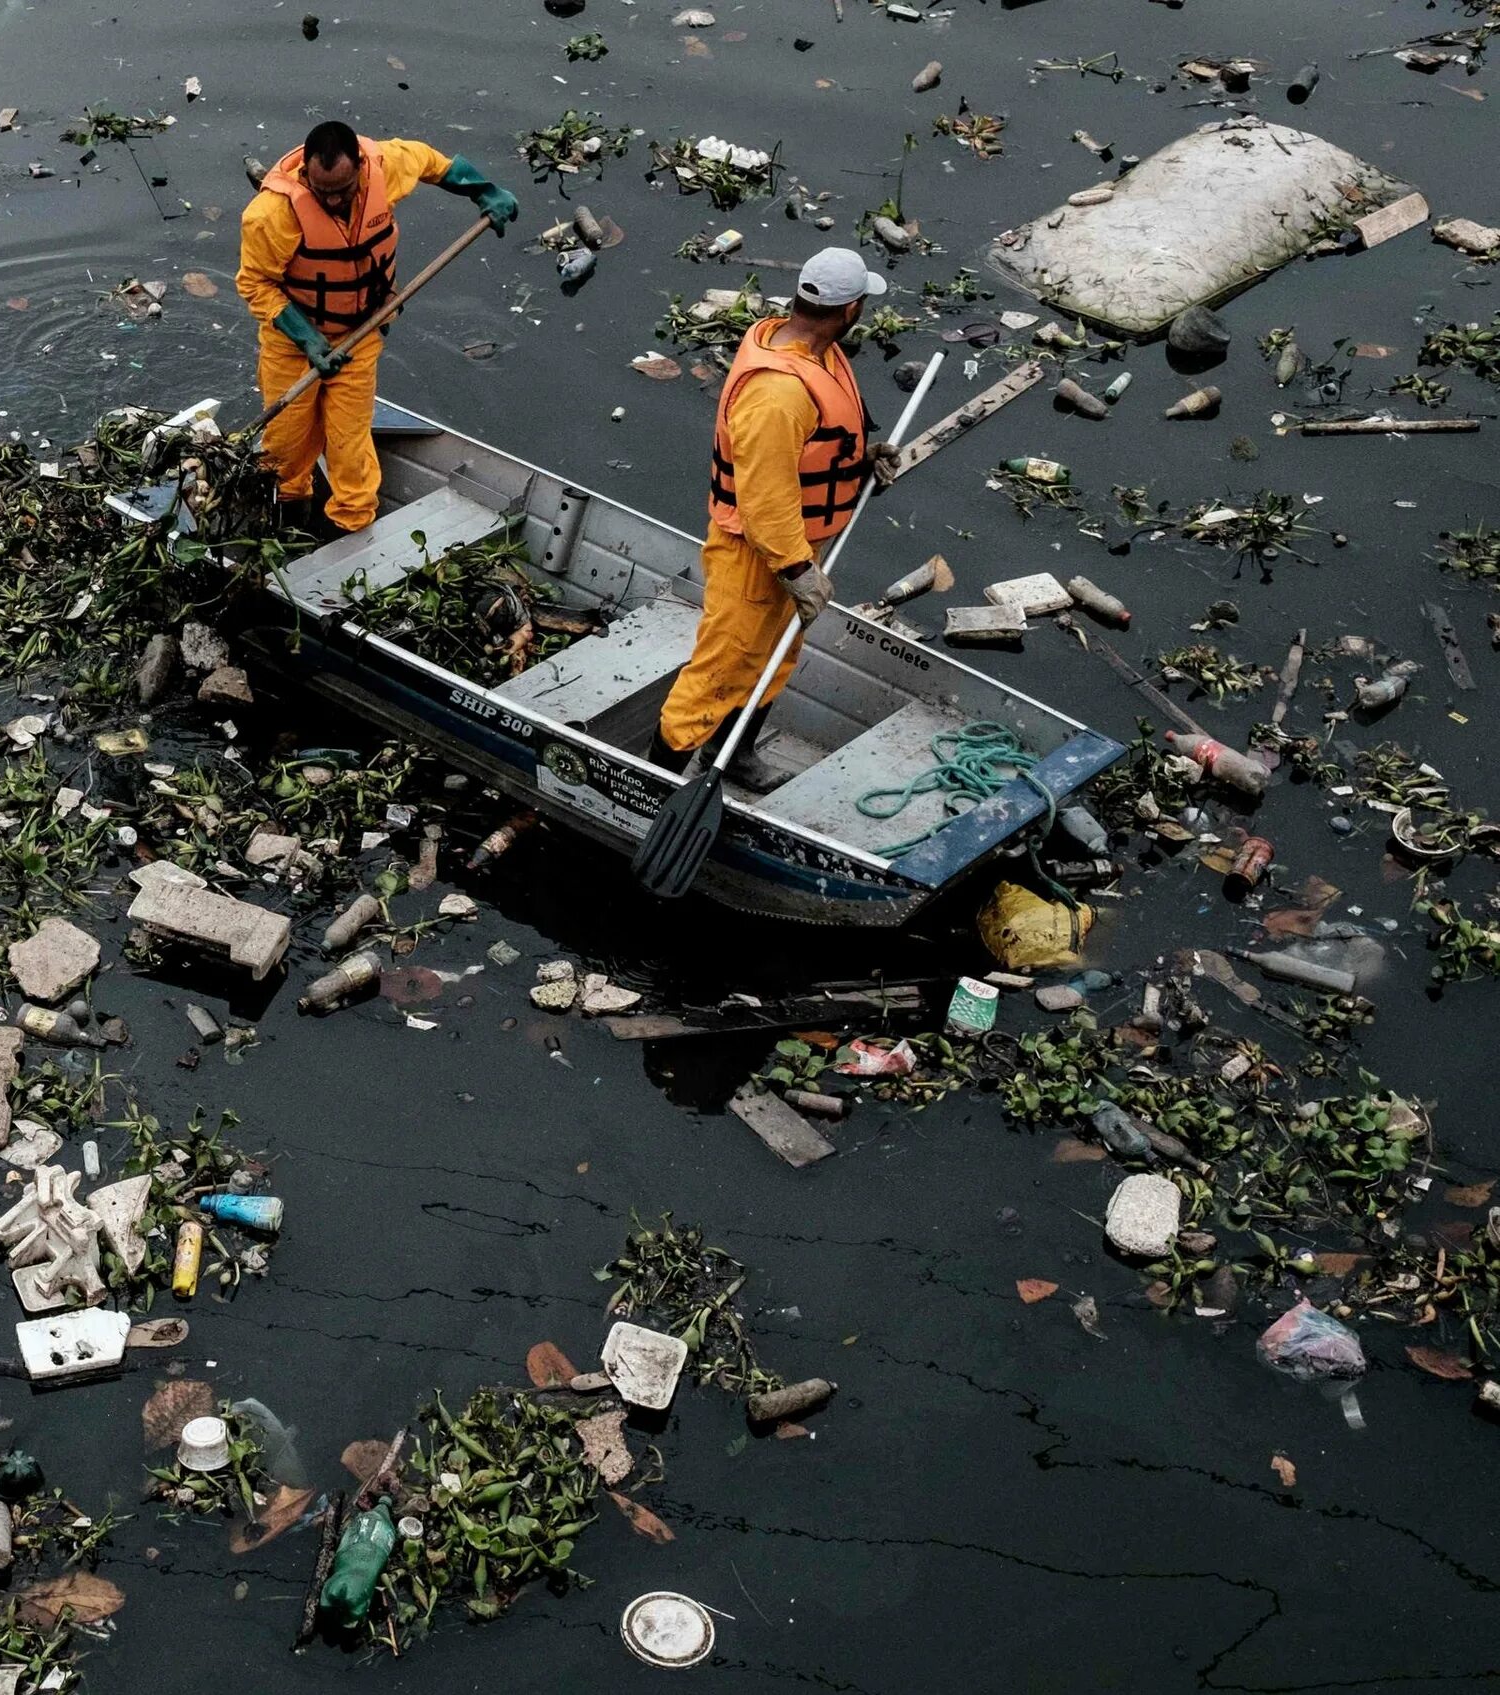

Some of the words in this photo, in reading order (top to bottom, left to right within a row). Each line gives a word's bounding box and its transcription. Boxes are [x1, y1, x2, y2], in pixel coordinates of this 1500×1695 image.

[846, 620, 875, 644] Use
[880, 638, 930, 671] Colete
[449, 689, 497, 718] SHIP
[500, 714, 533, 737] 300
[589, 757, 607, 772] Rio
[593, 772, 607, 783] eu
[613, 791, 627, 802] eu
